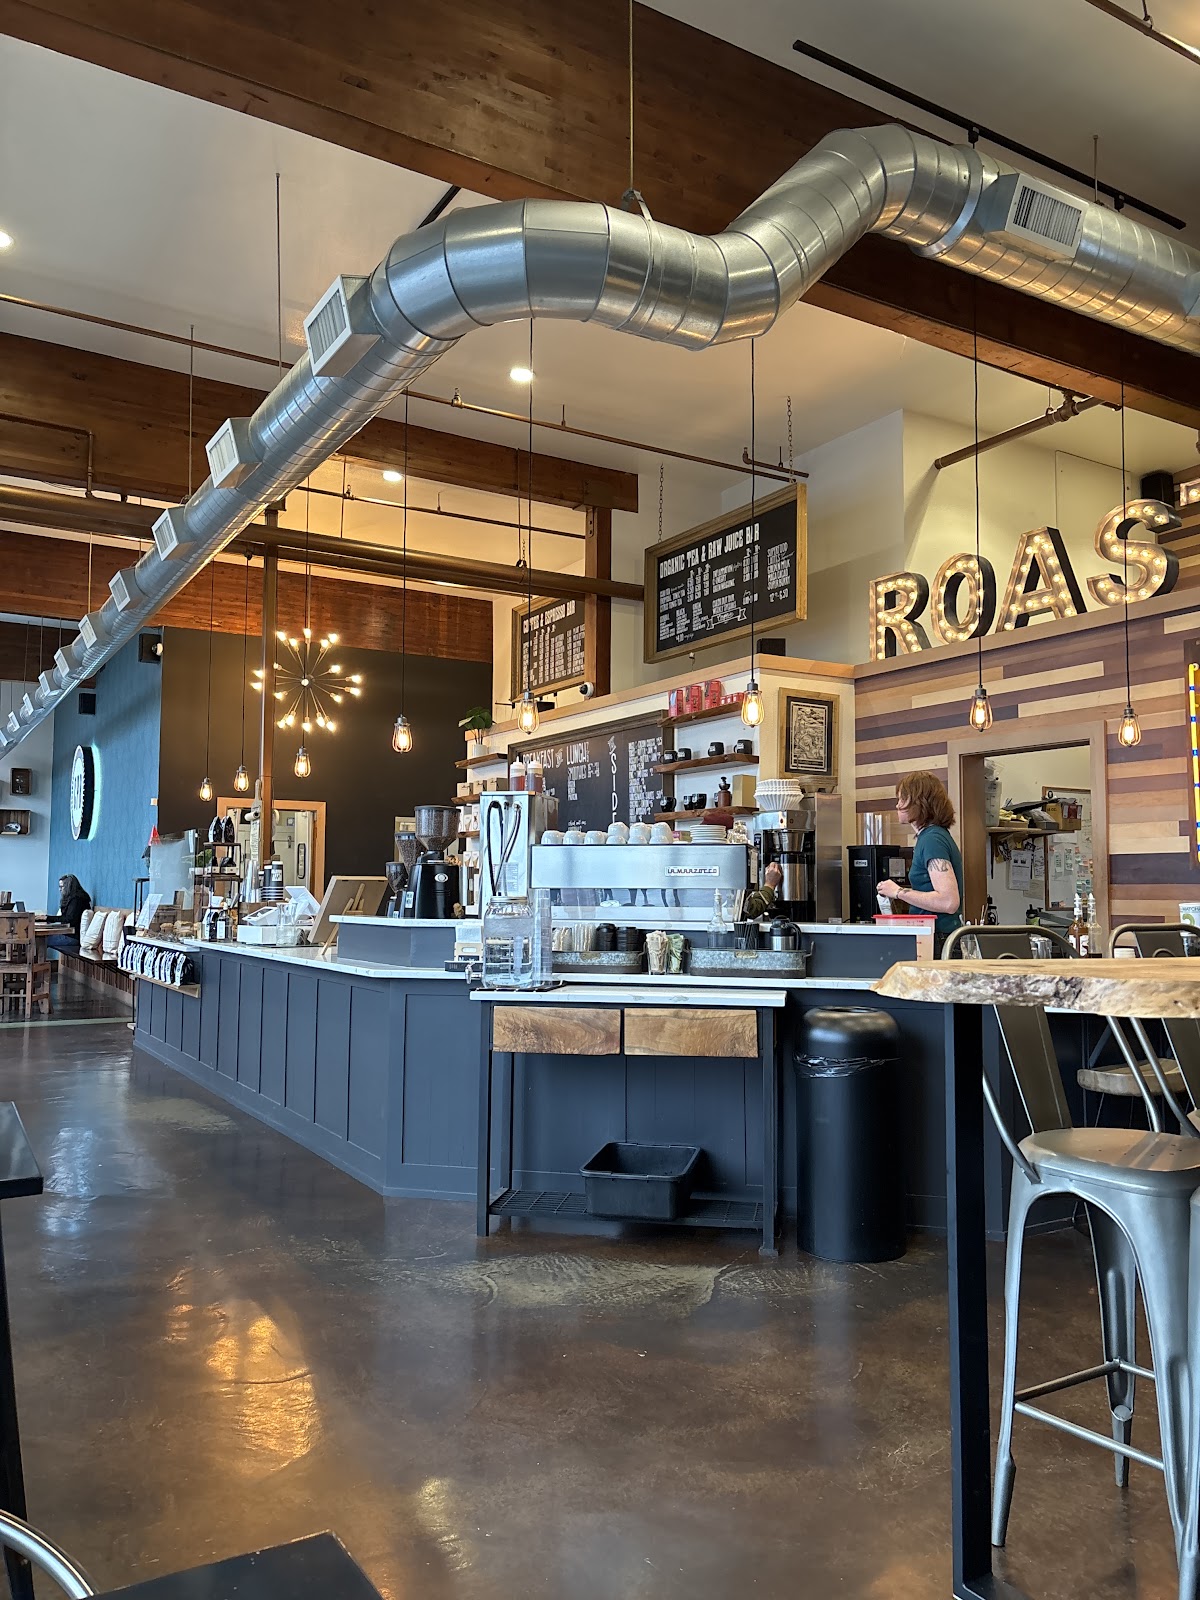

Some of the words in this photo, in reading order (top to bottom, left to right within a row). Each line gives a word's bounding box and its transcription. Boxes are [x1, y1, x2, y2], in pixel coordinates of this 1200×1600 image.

[660, 554, 685, 579] ORGANIC
[686, 547, 699, 568] TEA
[701, 545, 706, 562] &
[708, 537, 723, 560] RAW
[724, 529, 744, 553] JUICE
[746, 523, 760, 545] BAR
[869, 481, 1200, 662] ROAS
[523, 615, 539, 634] COFEE
[545, 604, 565, 625] ESPRESSO
[567, 600, 575, 617] BAR
[522, 749, 554, 769] BEAKFAST
[566, 742, 586, 765] LUNCH
